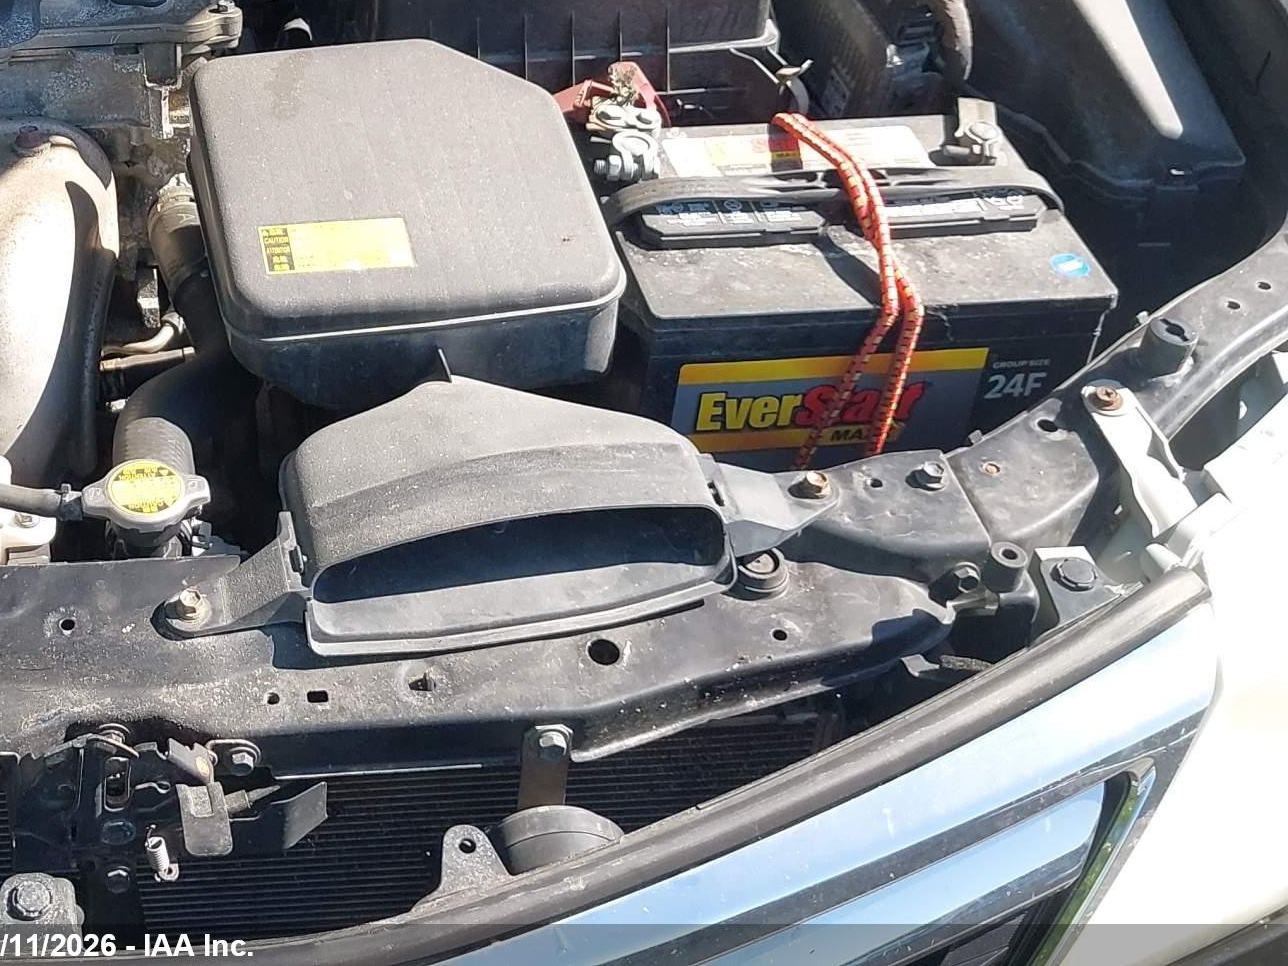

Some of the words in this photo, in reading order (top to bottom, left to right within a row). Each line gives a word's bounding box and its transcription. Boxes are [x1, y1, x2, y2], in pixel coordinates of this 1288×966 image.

[264, 236, 289, 244] CAUTION
[993, 360, 1027, 369] GROUP
[1029, 358, 1051, 366] SIZE
[984, 371, 1047, 399] 24F
[695, 383, 926, 432] EverSat
